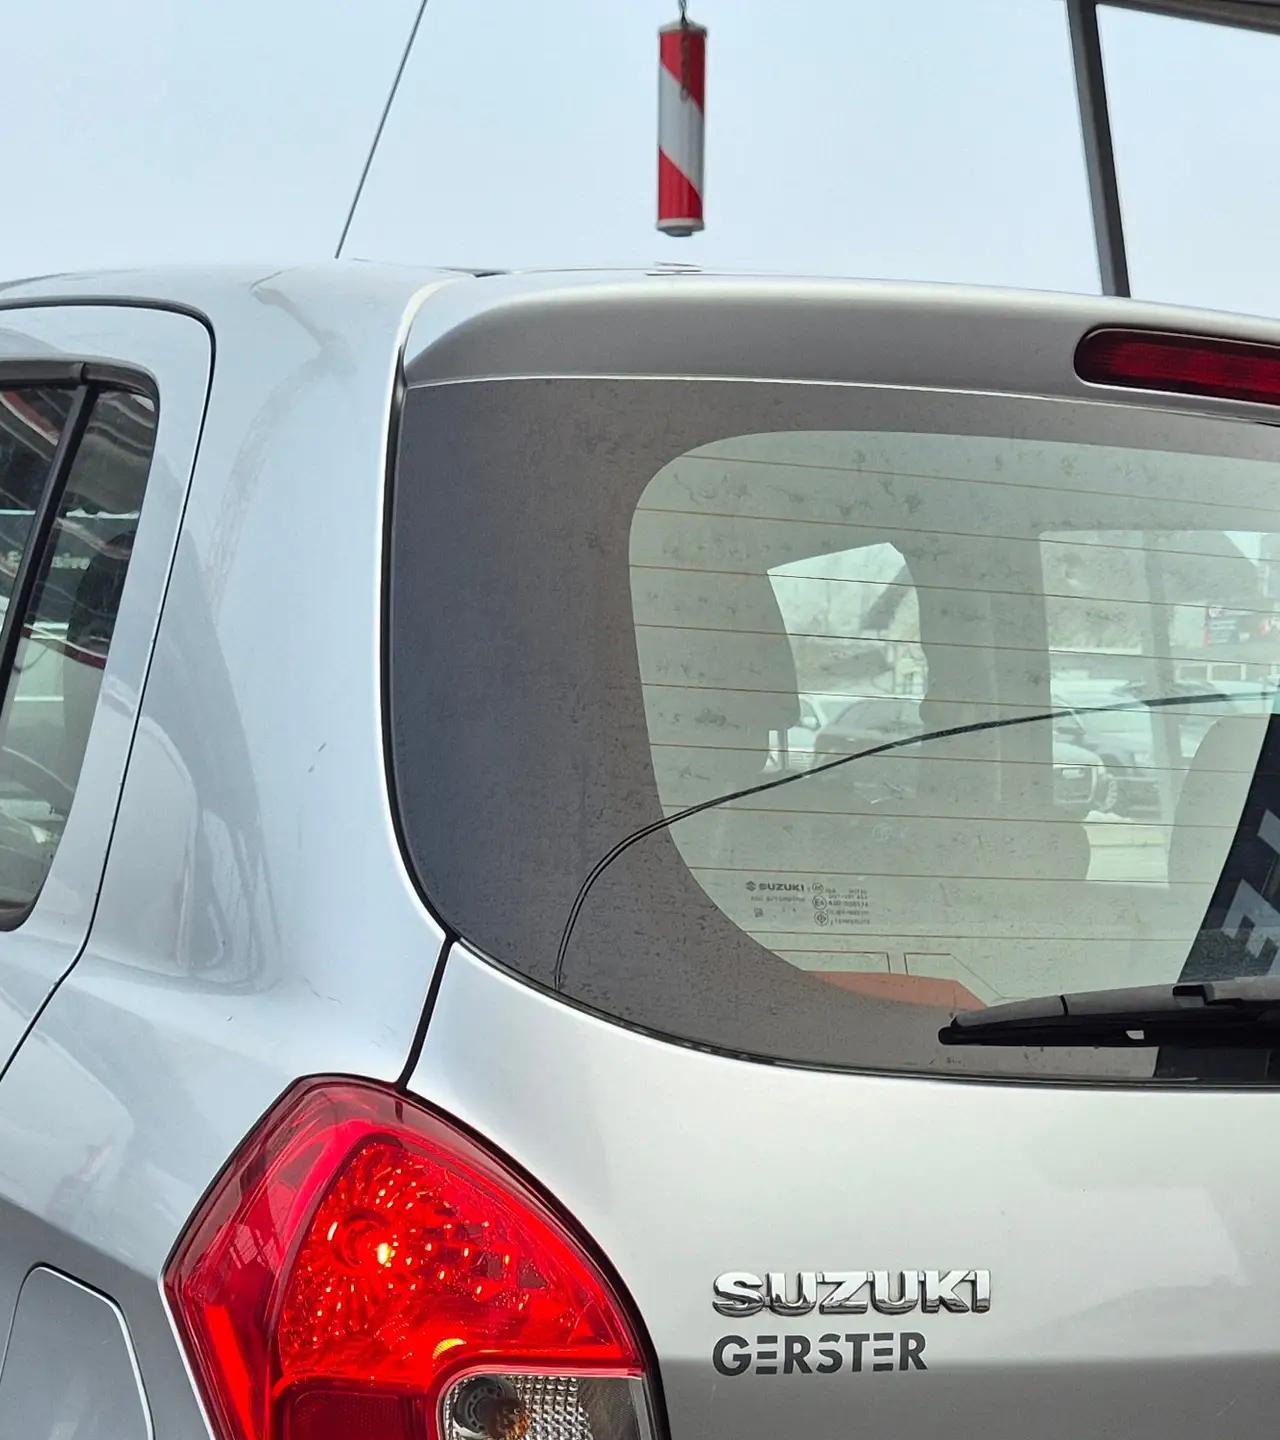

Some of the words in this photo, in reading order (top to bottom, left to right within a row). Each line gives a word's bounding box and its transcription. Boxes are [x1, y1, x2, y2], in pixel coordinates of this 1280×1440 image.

[759, 882, 805, 892] SUZUKI
[712, 1269, 991, 1317] SUZUKI
[712, 1331, 929, 1377] GERSTER
